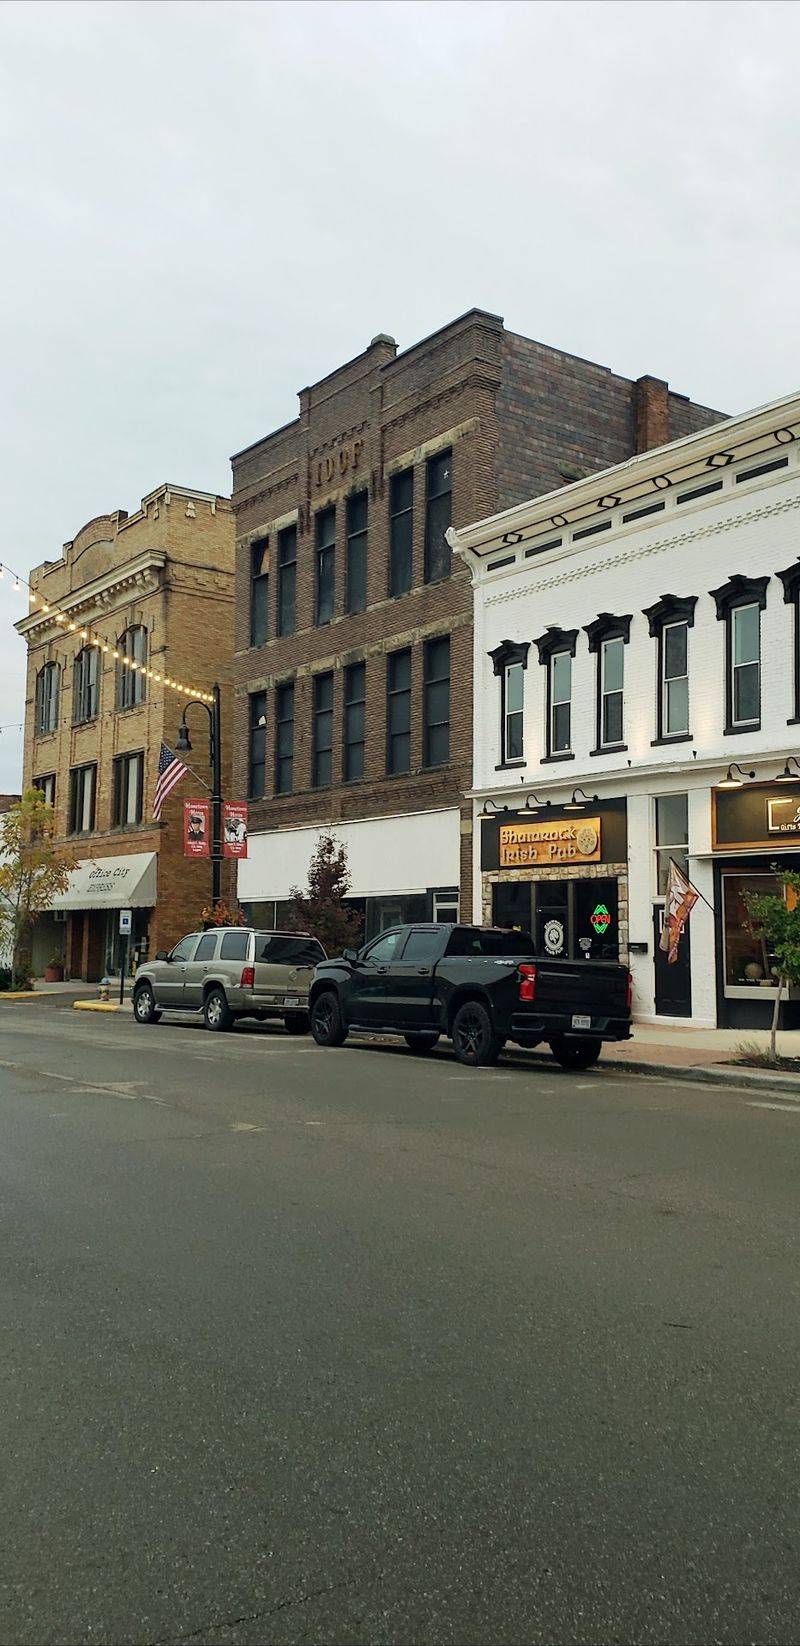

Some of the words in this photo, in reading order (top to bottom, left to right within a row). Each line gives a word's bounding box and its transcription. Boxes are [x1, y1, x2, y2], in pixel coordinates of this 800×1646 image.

[781, 823, 797, 831] Gifts
[501, 826, 577, 845] Shamrock
[502, 845, 538, 863] Irish
[549, 843, 577, 861] Pub
[89, 867, 112, 879] Office
[113, 867, 131, 879] City
[590, 914, 611, 924] OPEN
